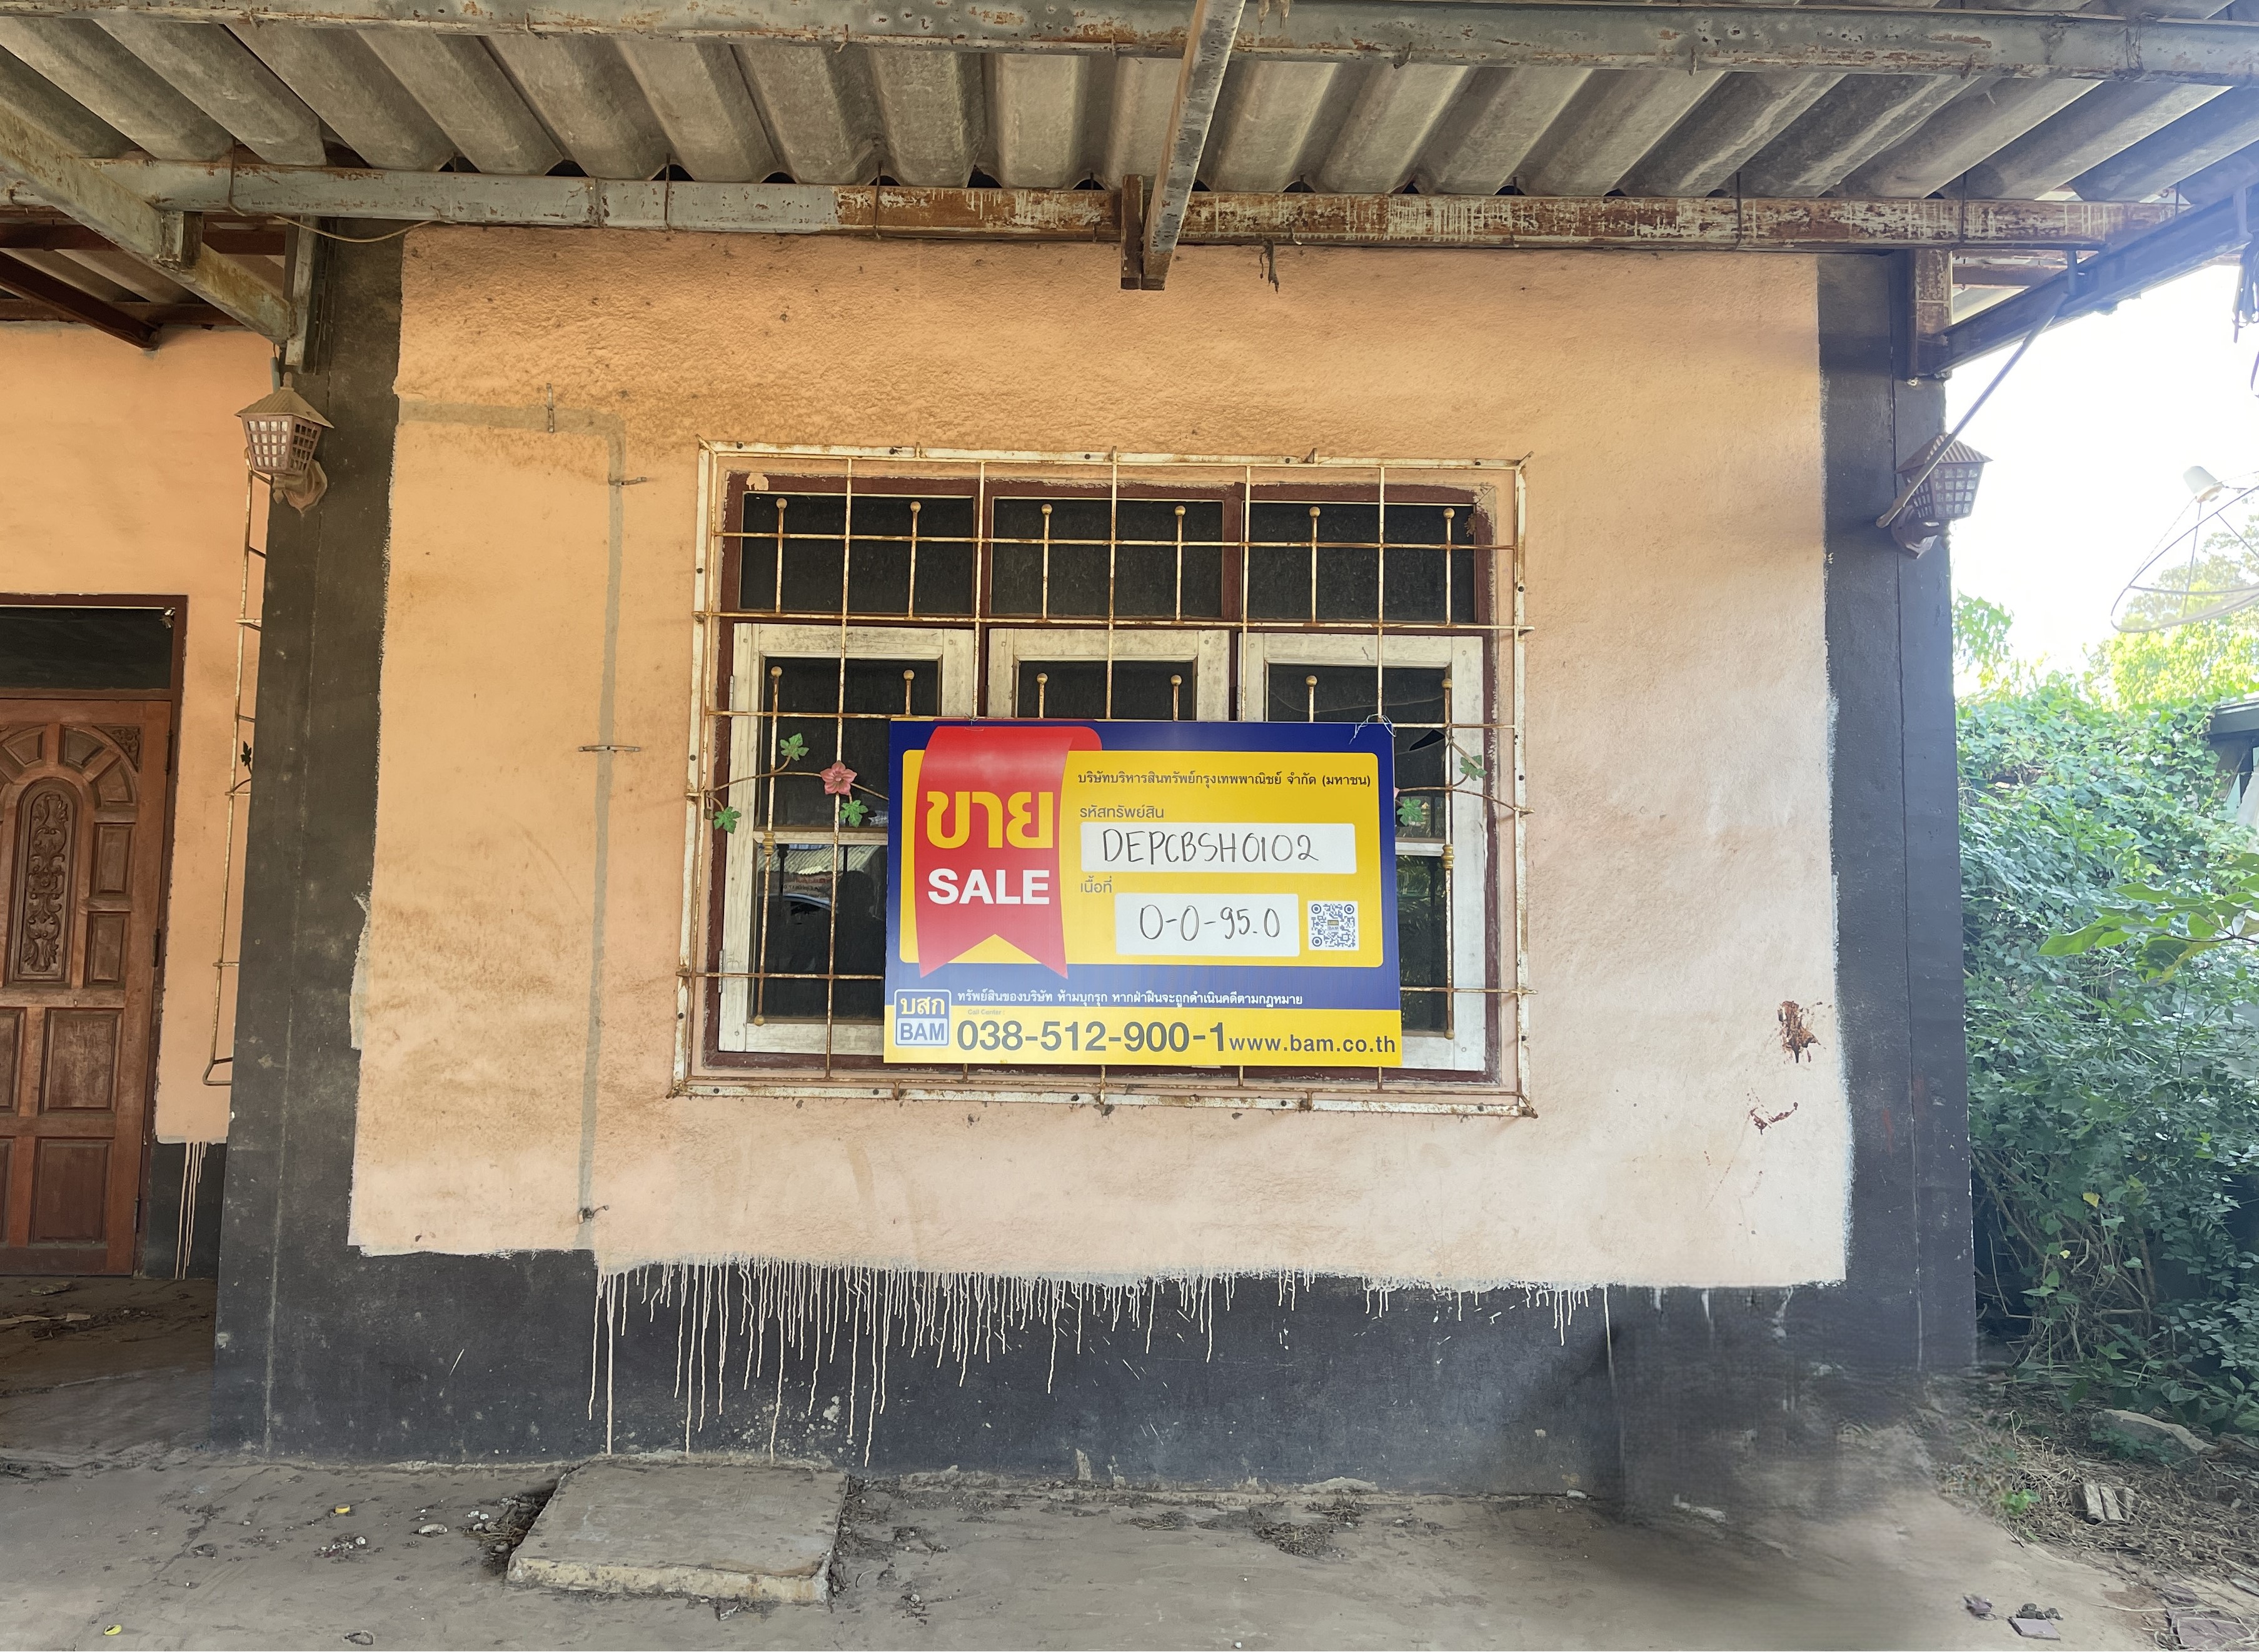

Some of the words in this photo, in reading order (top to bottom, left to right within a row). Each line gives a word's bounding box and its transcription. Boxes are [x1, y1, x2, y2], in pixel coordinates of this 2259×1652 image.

[1077, 770, 1282, 789] บริษัทบริหารสินทรัพย์กรุงเทพพาณิชย์
[1287, 771, 1316, 786] จำกัด
[1322, 774, 1371, 787] (มหาชน)
[926, 791, 1054, 849] ขาย
[1079, 804, 1165, 818] รหัสทรัพย์สิน
[927, 868, 1050, 905] SALE
[1080, 875, 1113, 894] เนื้อที่
[1139, 904, 1280, 942] 0-0-95.0
[900, 996, 945, 1015] บสก
[957, 988, 1053, 1003] ทรัพย์สินของบริษัท
[1057, 990, 1108, 1006] ห้ามบุกรุก
[1112, 990, 1303, 1008] หากฝ่าฝืนจะถูกดำเนินคดีตามกฎหมาย
[900, 1023, 945, 1041] BAM
[957, 1020, 1224, 1052] 038-512-900-1
[1229, 1034, 1396, 1053] www.bam.co.th
